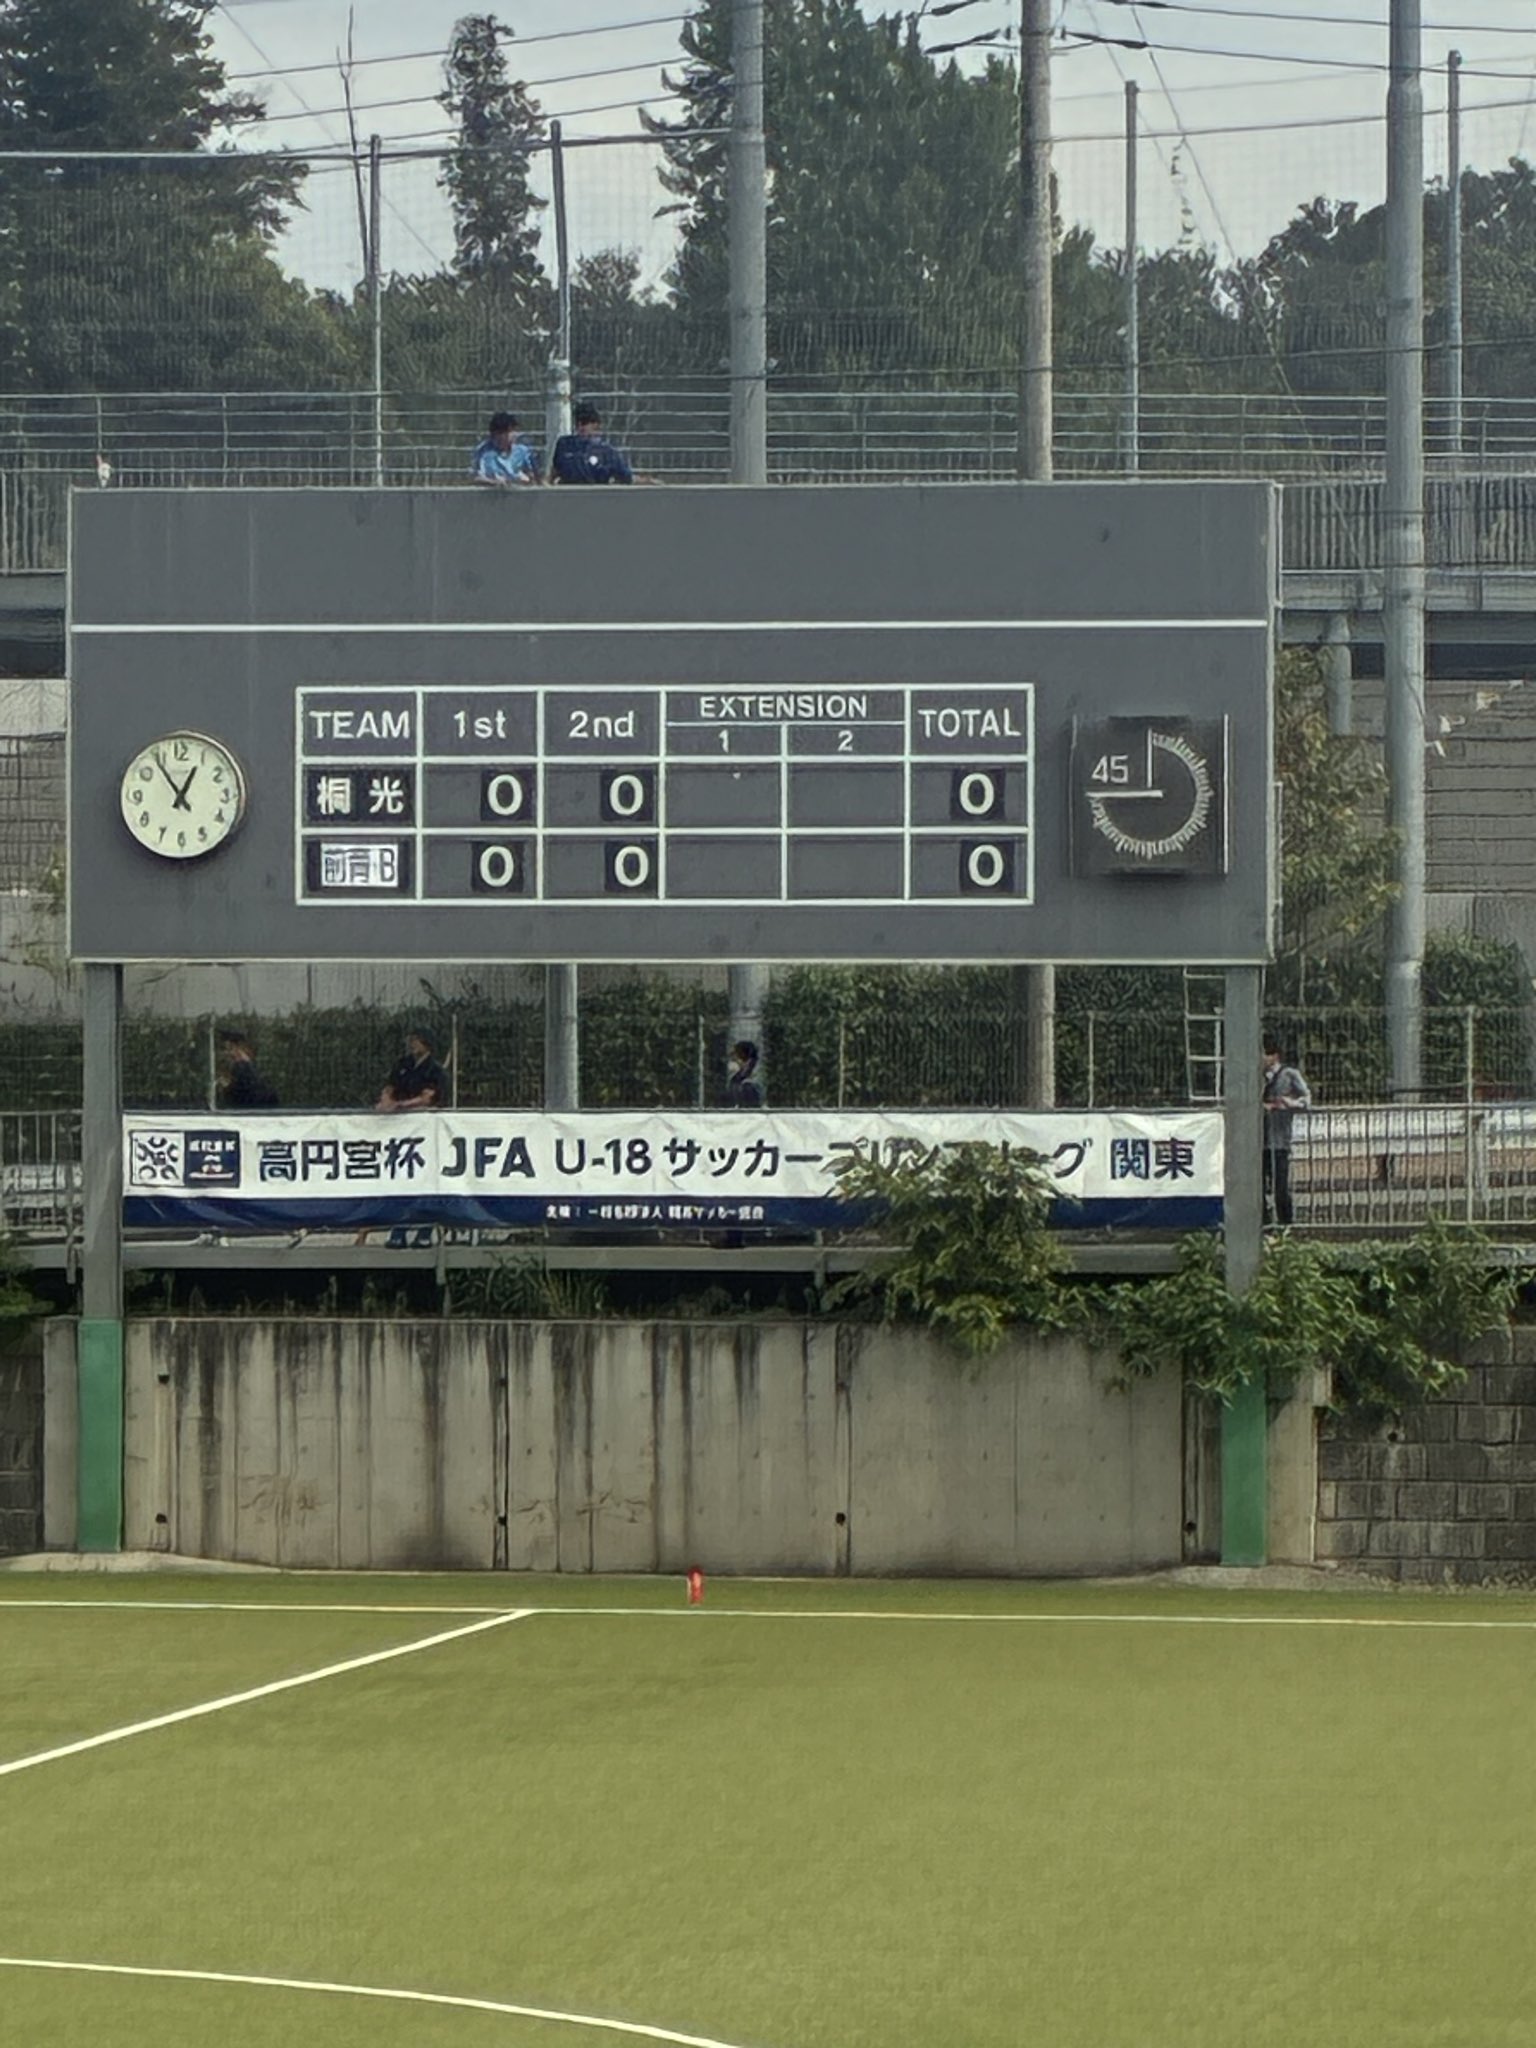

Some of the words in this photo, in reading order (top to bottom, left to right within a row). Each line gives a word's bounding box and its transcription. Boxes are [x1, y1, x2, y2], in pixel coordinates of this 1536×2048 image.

[309, 710, 410, 739] TEAM
[454, 710, 506, 739] 1st
[568, 710, 634, 738] 2nd
[700, 694, 867, 719] EXTENSION
[918, 708, 1022, 738] TOTAL
[173, 741, 190, 761] 12
[718, 729, 729, 753] 1
[837, 730, 853, 751] 2
[212, 765, 224, 783] 2
[1091, 755, 1129, 783] 45
[132, 789, 143, 805] 9
[219, 787, 229, 804] 3
[316, 775, 404, 815] 桐光
[487, 774, 523, 815] 0
[609, 774, 644, 815] 0
[959, 772, 995, 815] 0
[158, 826, 168, 844] 7
[177, 831, 186, 848] 6
[479, 845, 515, 888] 0
[614, 845, 649, 888] 0
[968, 844, 1004, 887] 0
[256, 1137, 426, 1181] 高円宮杯
[441, 1136, 536, 1178] JFA
[555, 1138, 652, 1175] U-18
[1110, 1137, 1196, 1180] 関東
